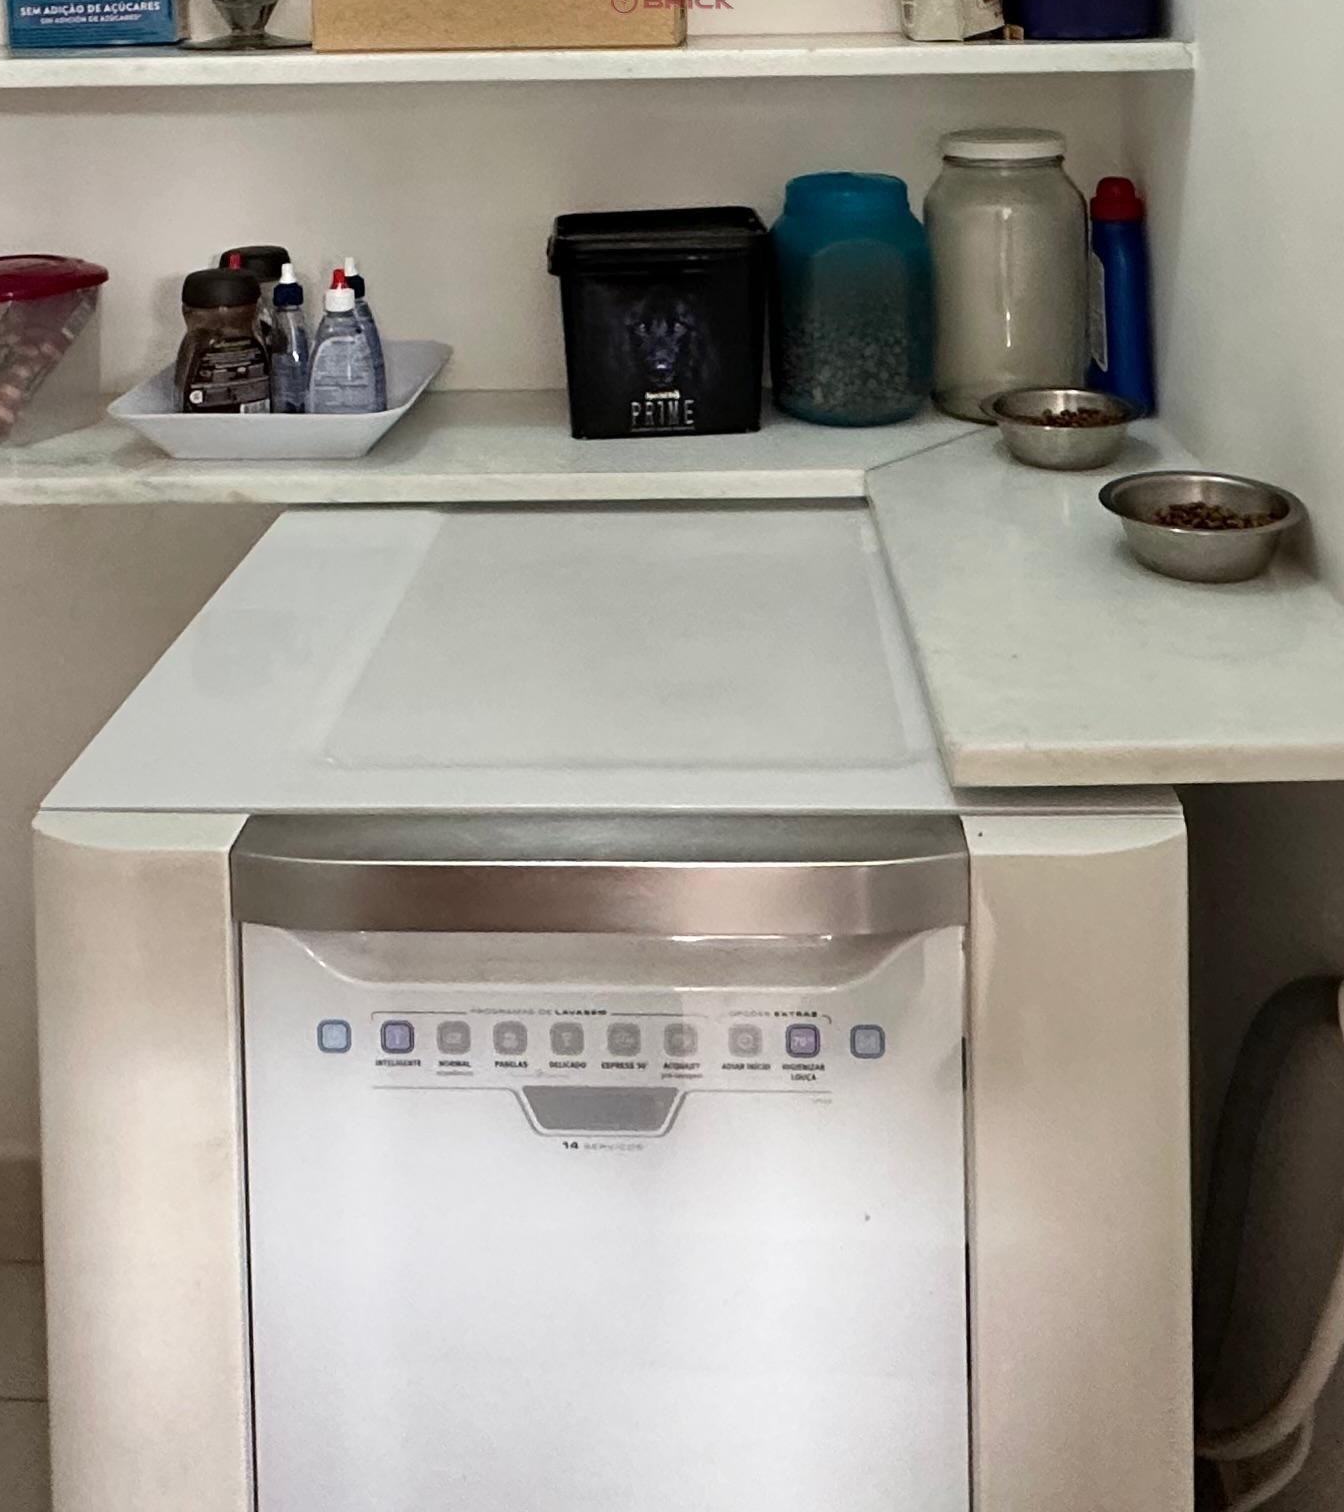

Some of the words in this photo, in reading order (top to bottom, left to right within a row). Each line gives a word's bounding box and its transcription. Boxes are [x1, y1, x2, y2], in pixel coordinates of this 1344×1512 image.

[20, 5, 42, 17] SEM
[43, 2, 85, 16] ADIÇÃO
[87, 4, 100, 14] DE
[104, 1, 161, 15] AÇÚCARES
[562, 1141, 579, 1150] 14
